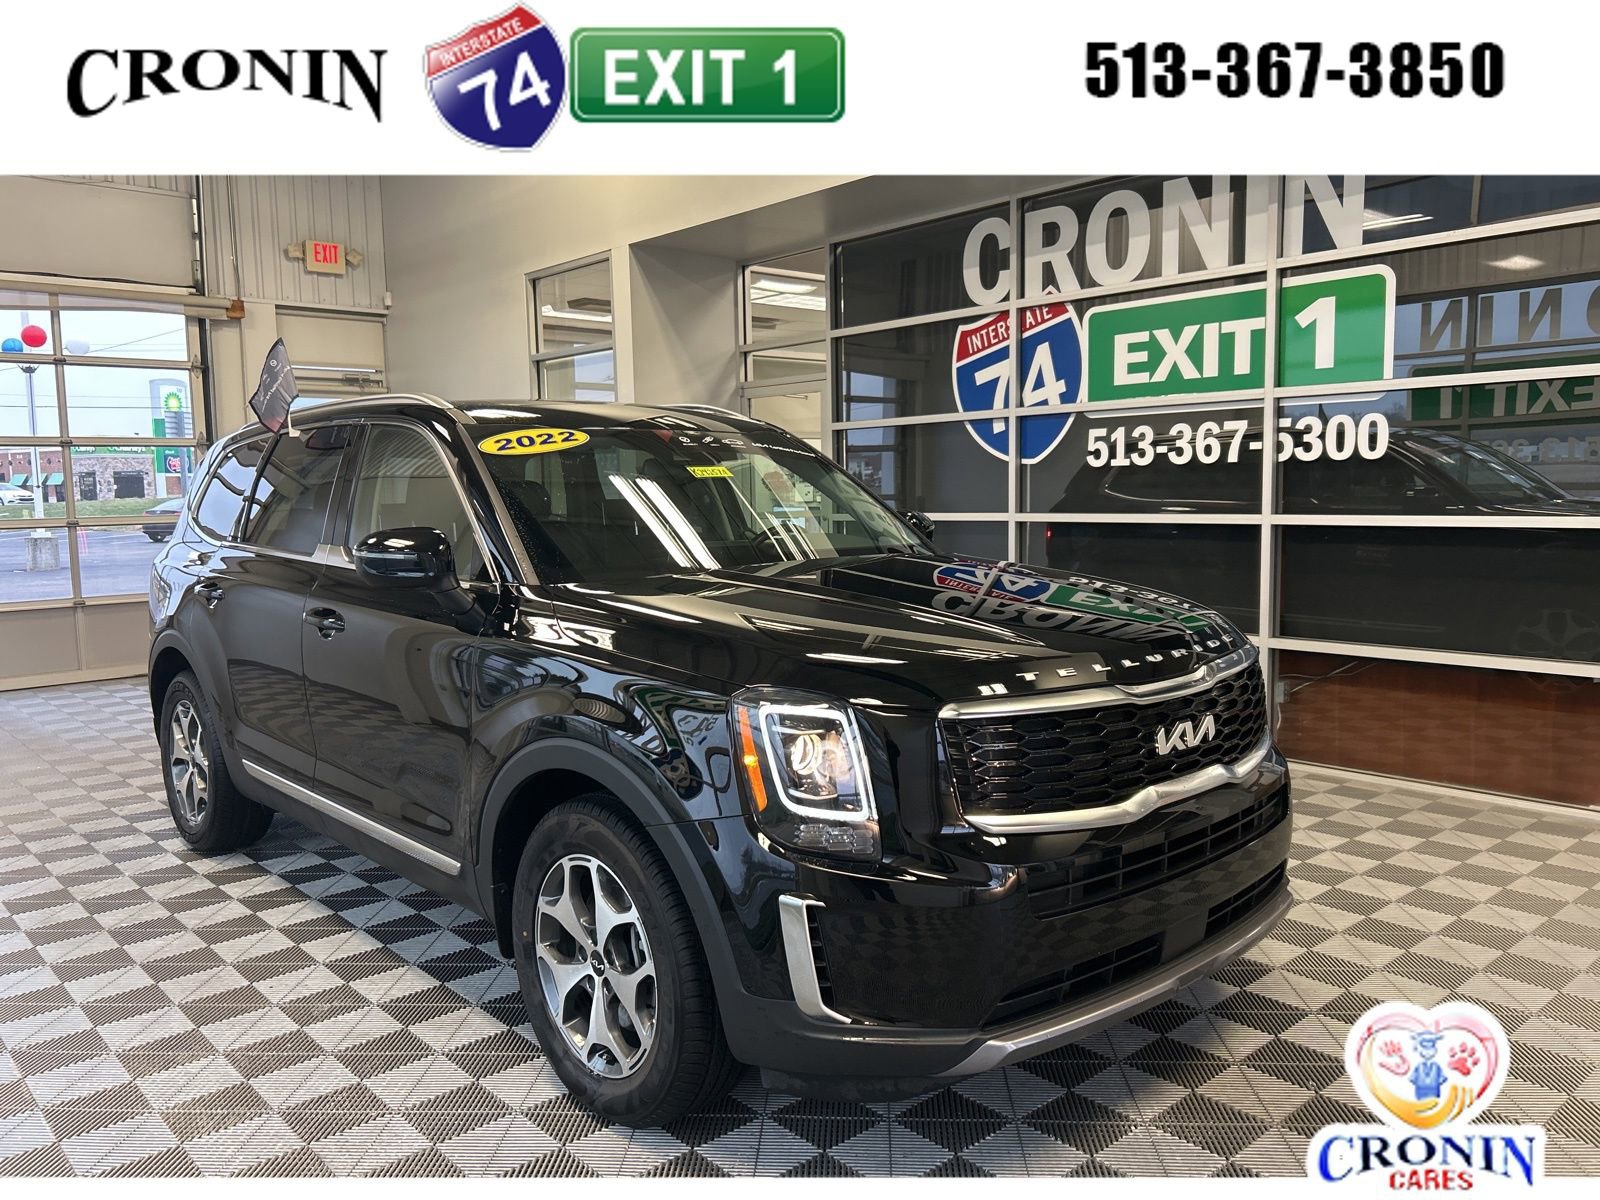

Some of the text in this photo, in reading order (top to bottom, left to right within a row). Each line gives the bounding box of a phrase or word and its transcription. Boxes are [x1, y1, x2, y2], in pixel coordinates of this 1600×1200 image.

[313, 242, 339, 265] EXIT
[962, 174, 1365, 306] CRONIN
[966, 305, 1053, 354] INTERATE
[1113, 296, 1336, 386] EXIT 1
[974, 341, 1067, 435] 74
[493, 431, 579, 451] 2022
[1086, 412, 1389, 468] 513-367-5300
[1015, 633, 1235, 682] TELLURIDE
[1155, 712, 1216, 756] KIA
